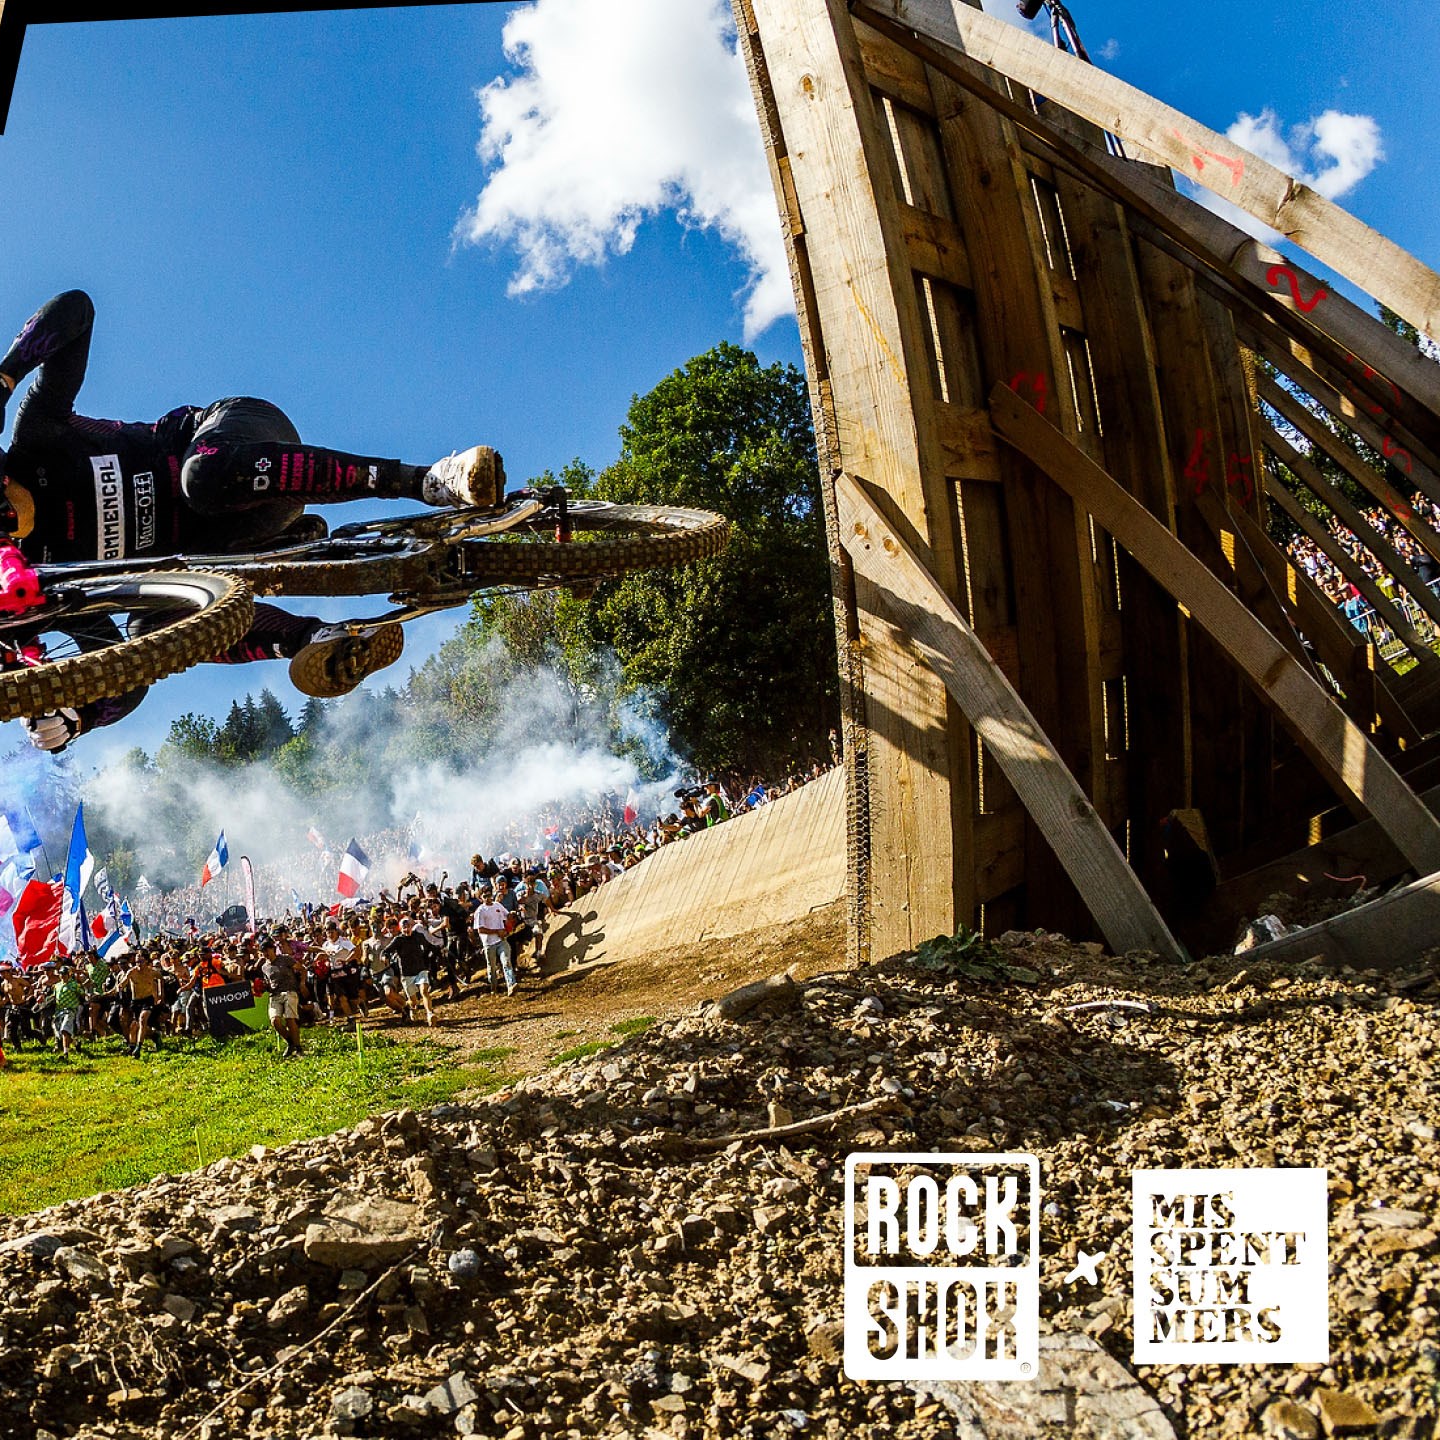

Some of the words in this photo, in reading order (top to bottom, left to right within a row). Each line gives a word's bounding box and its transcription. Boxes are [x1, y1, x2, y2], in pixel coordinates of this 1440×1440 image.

[1266, 265, 1328, 313] 2
[99, 461, 120, 560] OMMENCAL
[136, 473, 153, 549] Muc-Off
[208, 989, 250, 1005] WHOOP
